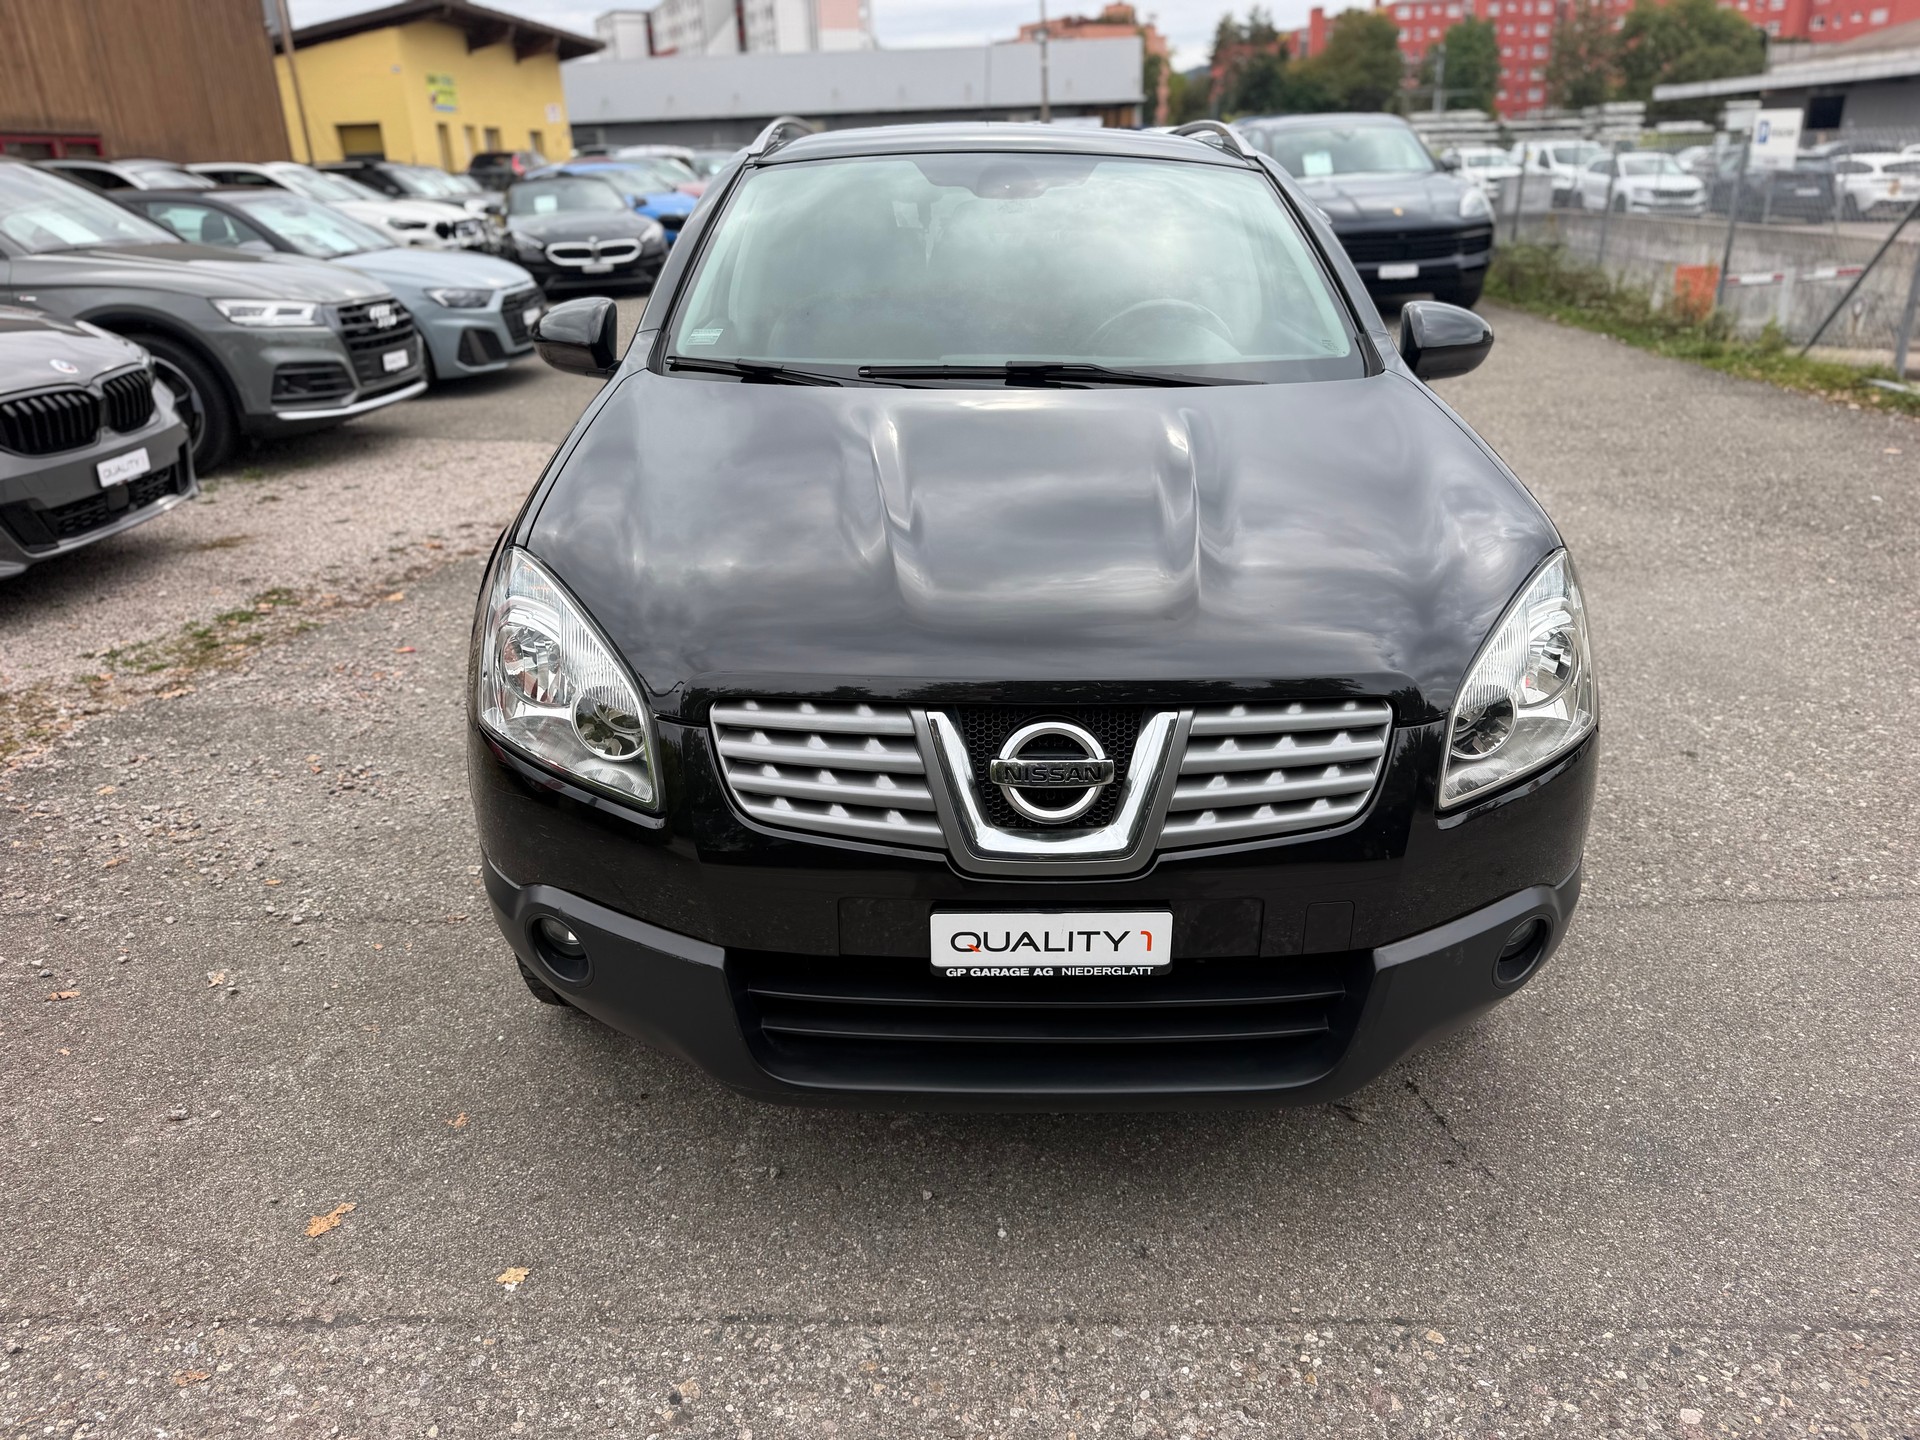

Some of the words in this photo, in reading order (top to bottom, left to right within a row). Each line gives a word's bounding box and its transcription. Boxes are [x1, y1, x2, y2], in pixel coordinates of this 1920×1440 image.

[1004, 766, 1102, 782] NISSAN
[950, 931, 1131, 952] QUALITY
[1140, 930, 1153, 951] 1
[946, 968, 967, 977] GP
[970, 968, 1030, 977] GARAGE
[1033, 968, 1054, 977] AG
[1061, 967, 1153, 976] NIEDERGLATT
